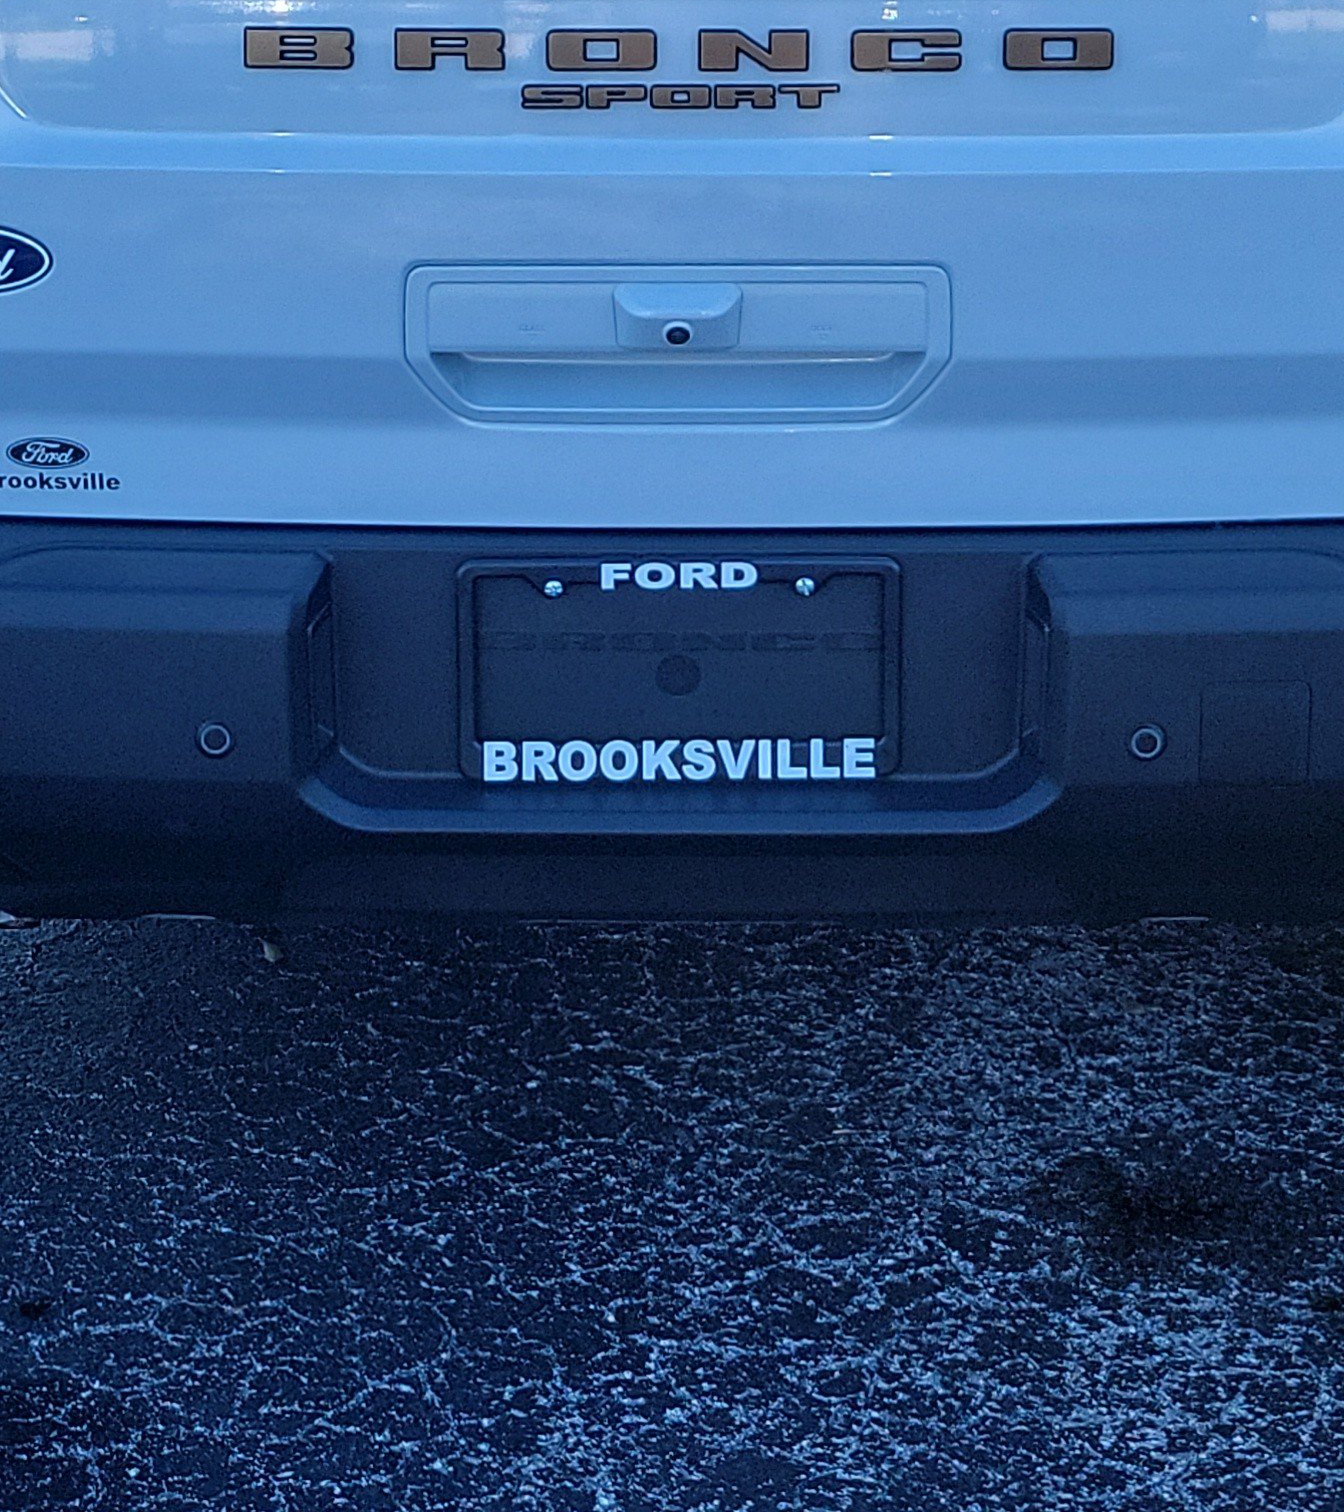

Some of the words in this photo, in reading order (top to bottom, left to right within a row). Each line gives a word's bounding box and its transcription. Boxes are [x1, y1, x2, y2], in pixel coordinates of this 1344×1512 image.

[242, 26, 1116, 72] BRONCO
[521, 84, 841, 110] SPORT
[600, 562, 758, 590] FORD
[482, 738, 876, 782] BROOKSVILLE
